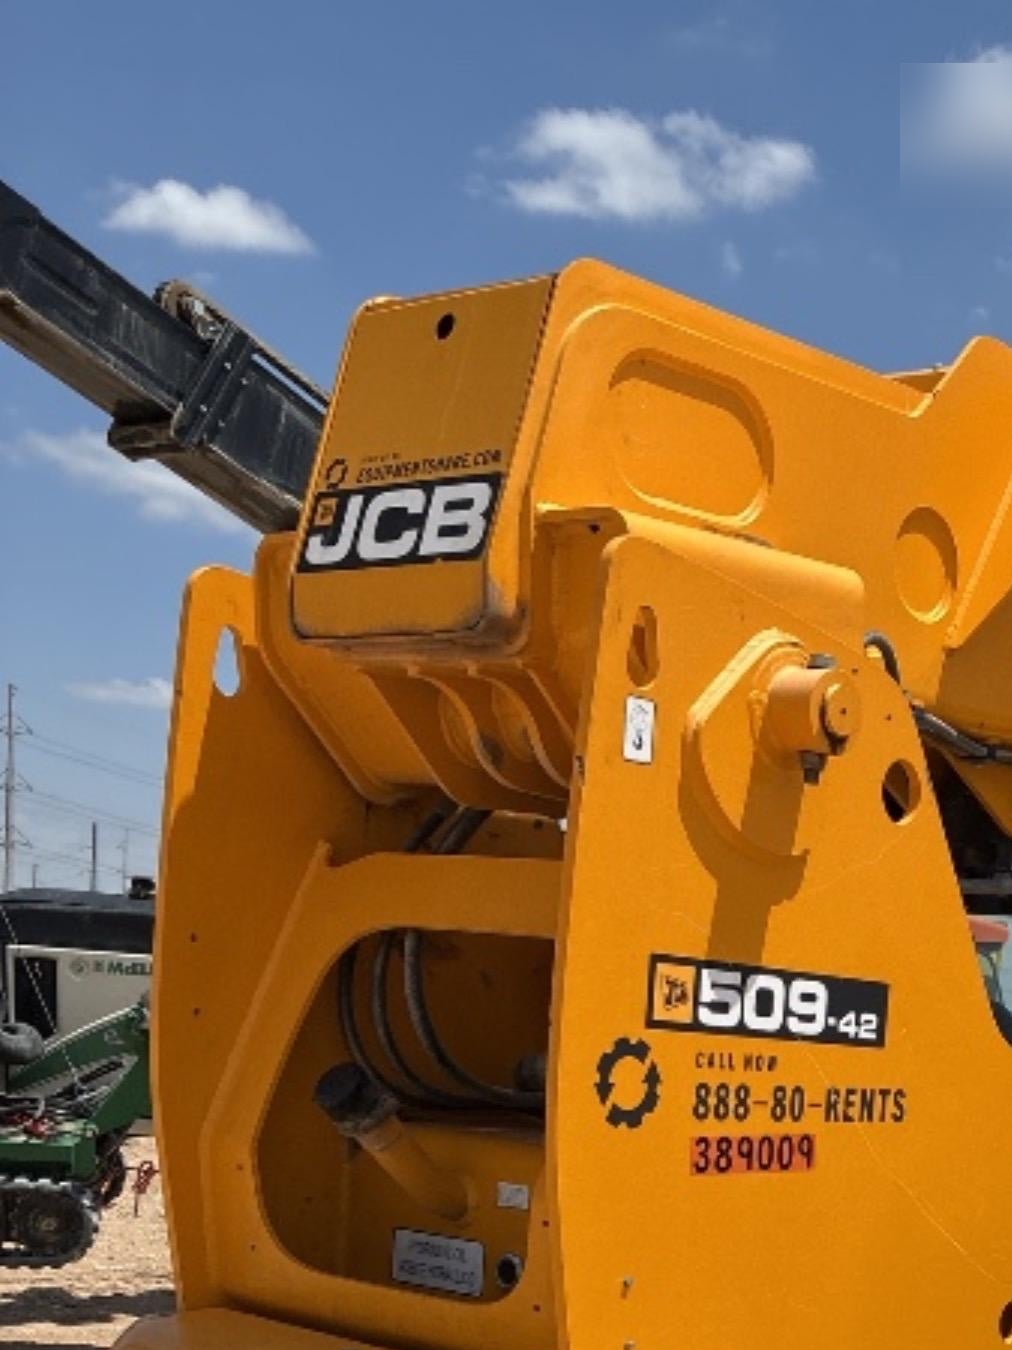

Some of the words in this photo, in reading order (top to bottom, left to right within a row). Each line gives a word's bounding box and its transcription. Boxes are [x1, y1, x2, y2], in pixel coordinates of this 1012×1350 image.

[305, 482, 492, 565] JCB
[695, 1052, 736, 1071] CALL
[743, 1055, 778, 1072] NOW
[692, 1082, 907, 1123] 888-80-RENTS
[694, 1134, 814, 1174] 389009
